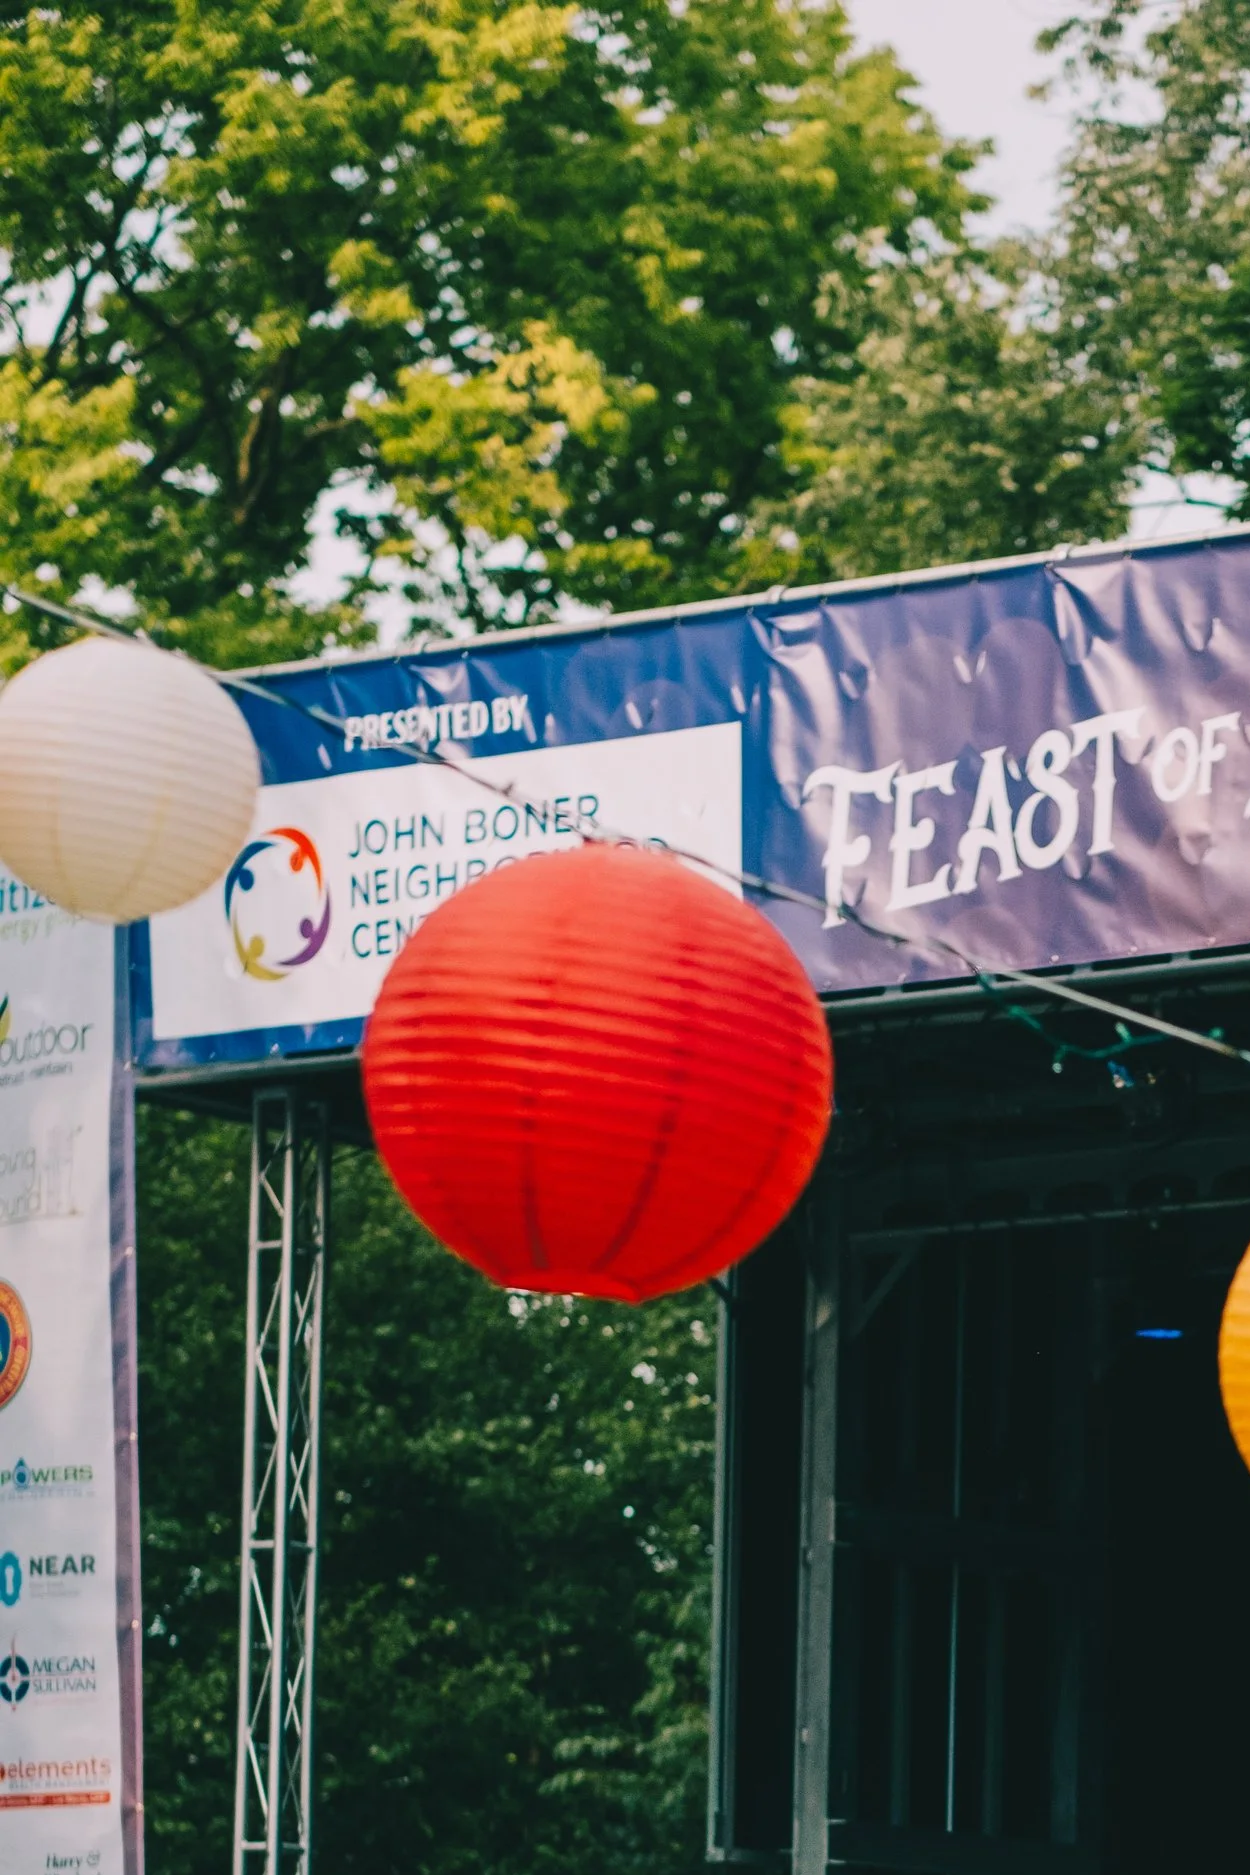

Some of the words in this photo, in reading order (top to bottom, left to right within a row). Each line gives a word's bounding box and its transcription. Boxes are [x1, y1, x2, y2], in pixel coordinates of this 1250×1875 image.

[345, 700, 488, 752] PRESENTED
[492, 694, 528, 733] BY
[349, 813, 444, 858] JOHN
[465, 795, 600, 845] BONER
[802, 706, 1146, 930] FEAST
[1151, 712, 1241, 802] OF
[29, 1554, 96, 1577] NEAR
[33, 1656, 96, 1674] MEGAN
[33, 1676, 97, 1693] SULLIVAN
[8, 1756, 111, 1779] elements
